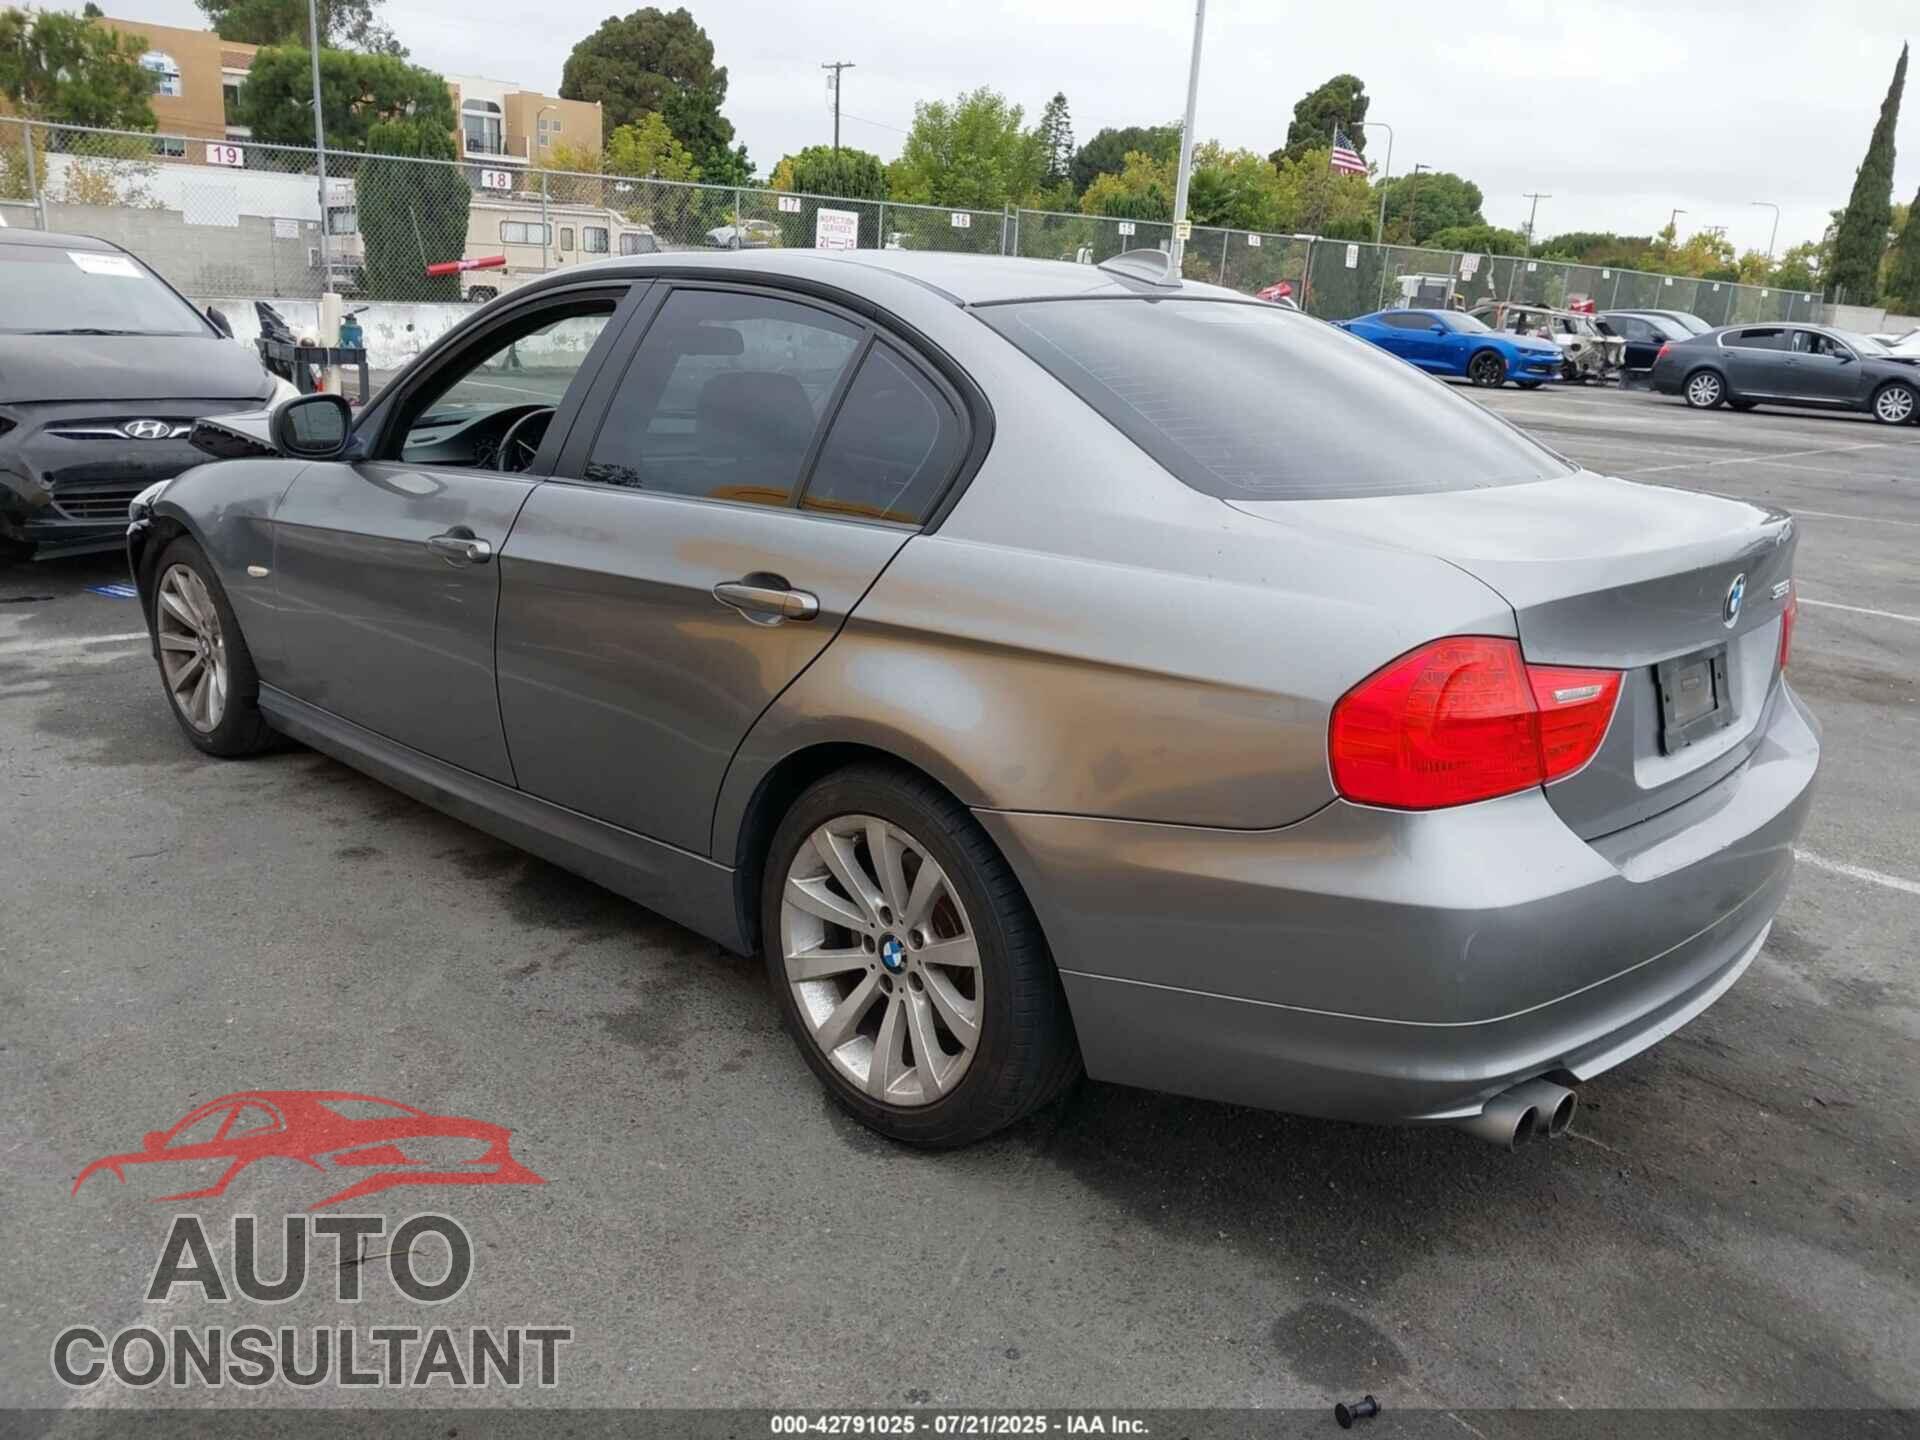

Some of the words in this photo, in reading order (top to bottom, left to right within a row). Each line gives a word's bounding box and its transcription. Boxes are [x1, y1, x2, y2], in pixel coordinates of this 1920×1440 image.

[213, 146, 237, 164] 19
[487, 172, 506, 187] 18
[783, 198, 797, 211] 17
